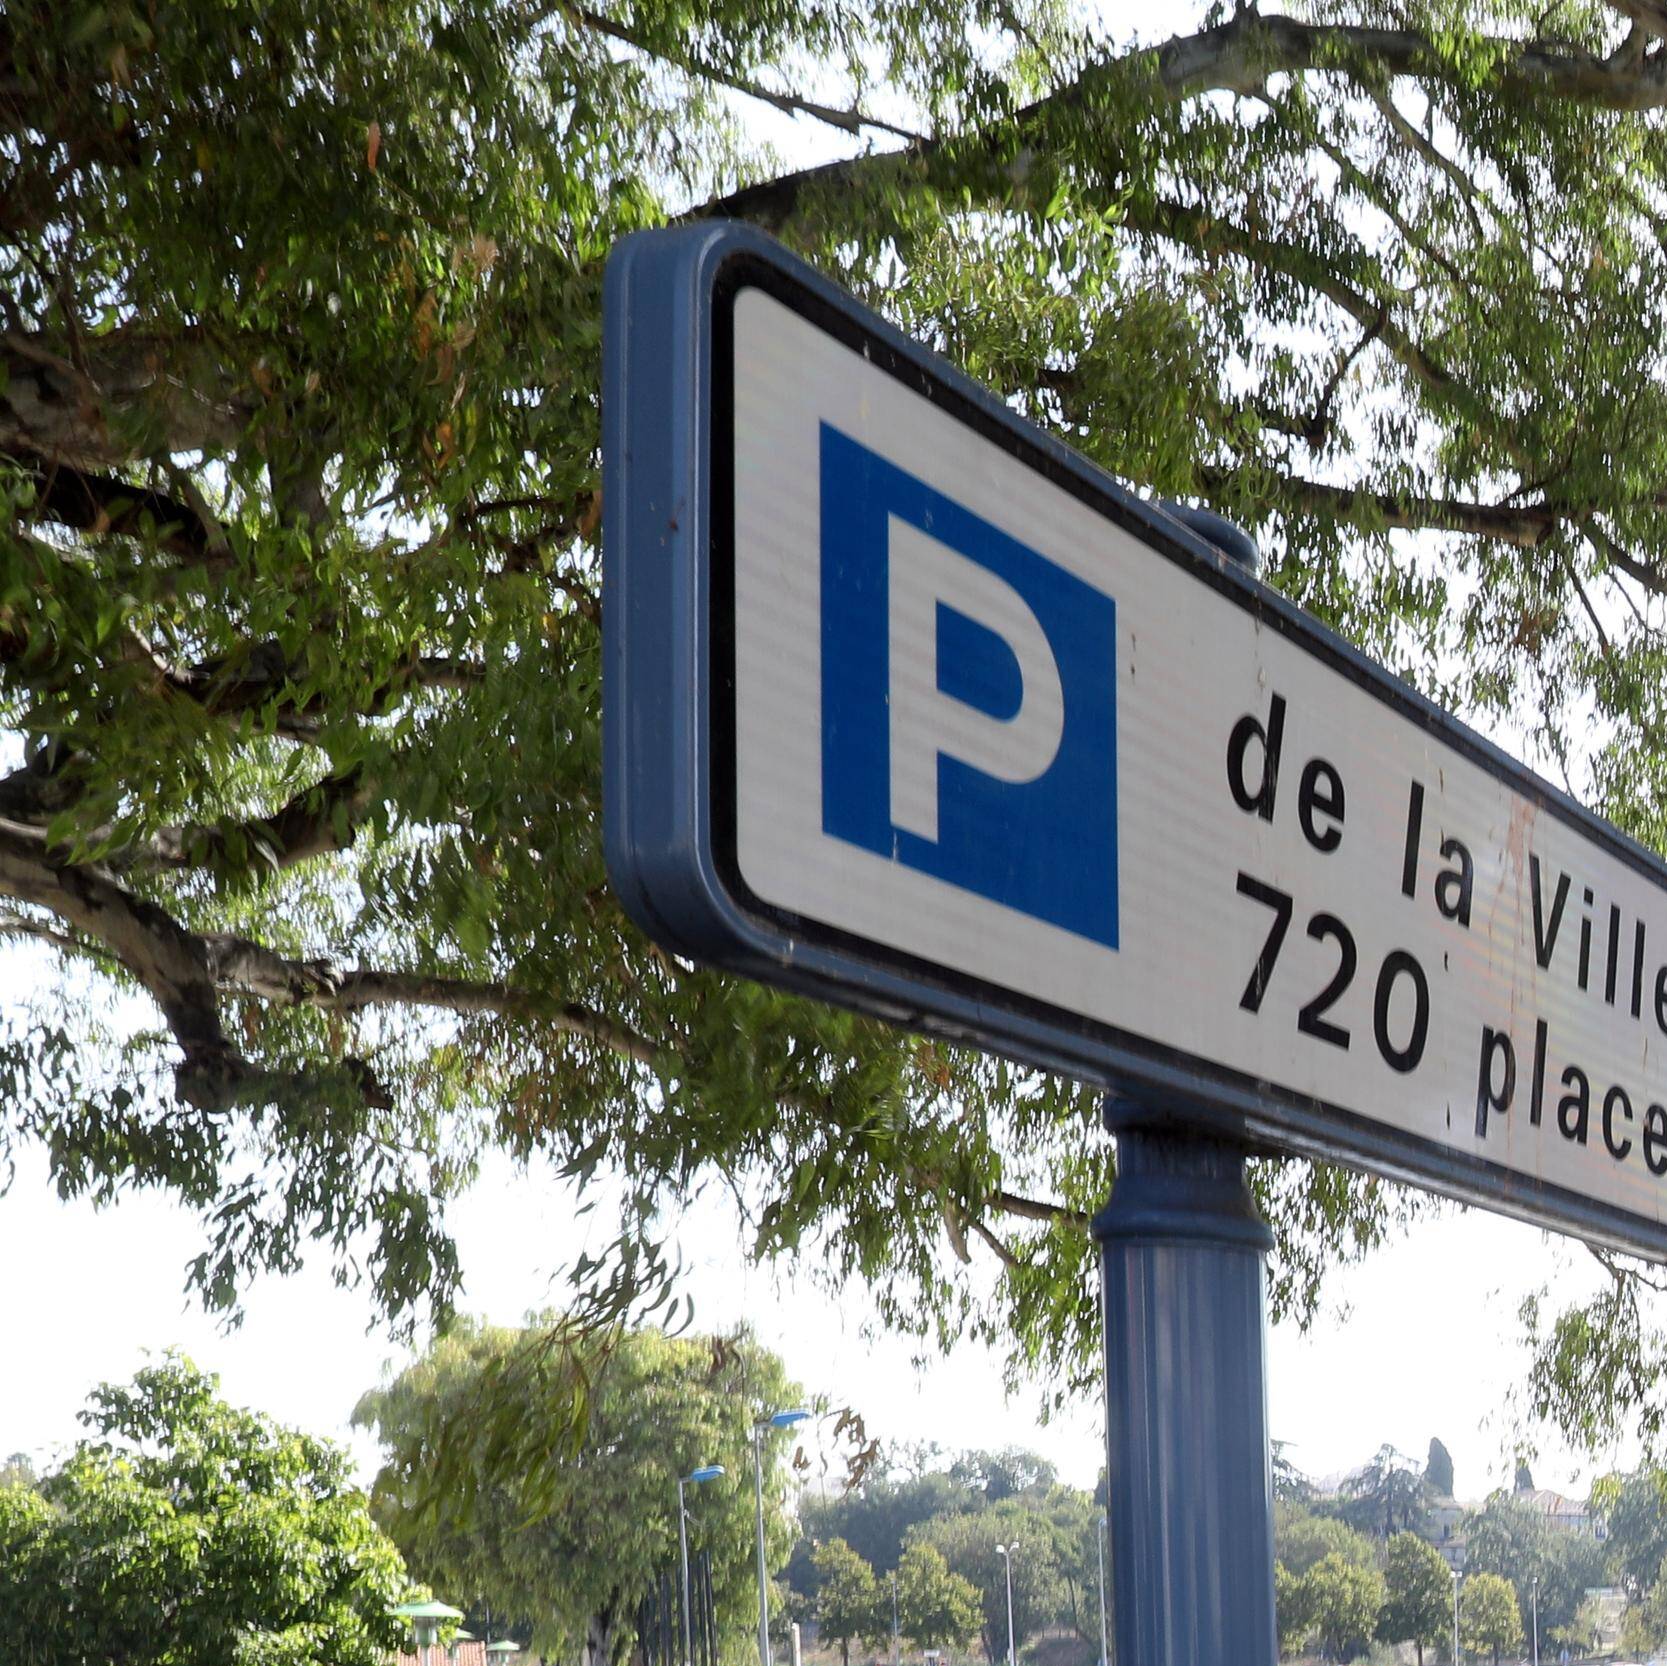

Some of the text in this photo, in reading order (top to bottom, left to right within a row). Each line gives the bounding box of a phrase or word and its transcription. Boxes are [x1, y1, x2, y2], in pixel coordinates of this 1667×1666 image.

[888, 510, 1065, 845] P
[1226, 693, 1346, 854] de
[1401, 779, 1474, 928] la
[1235, 870, 1430, 1075] 720
